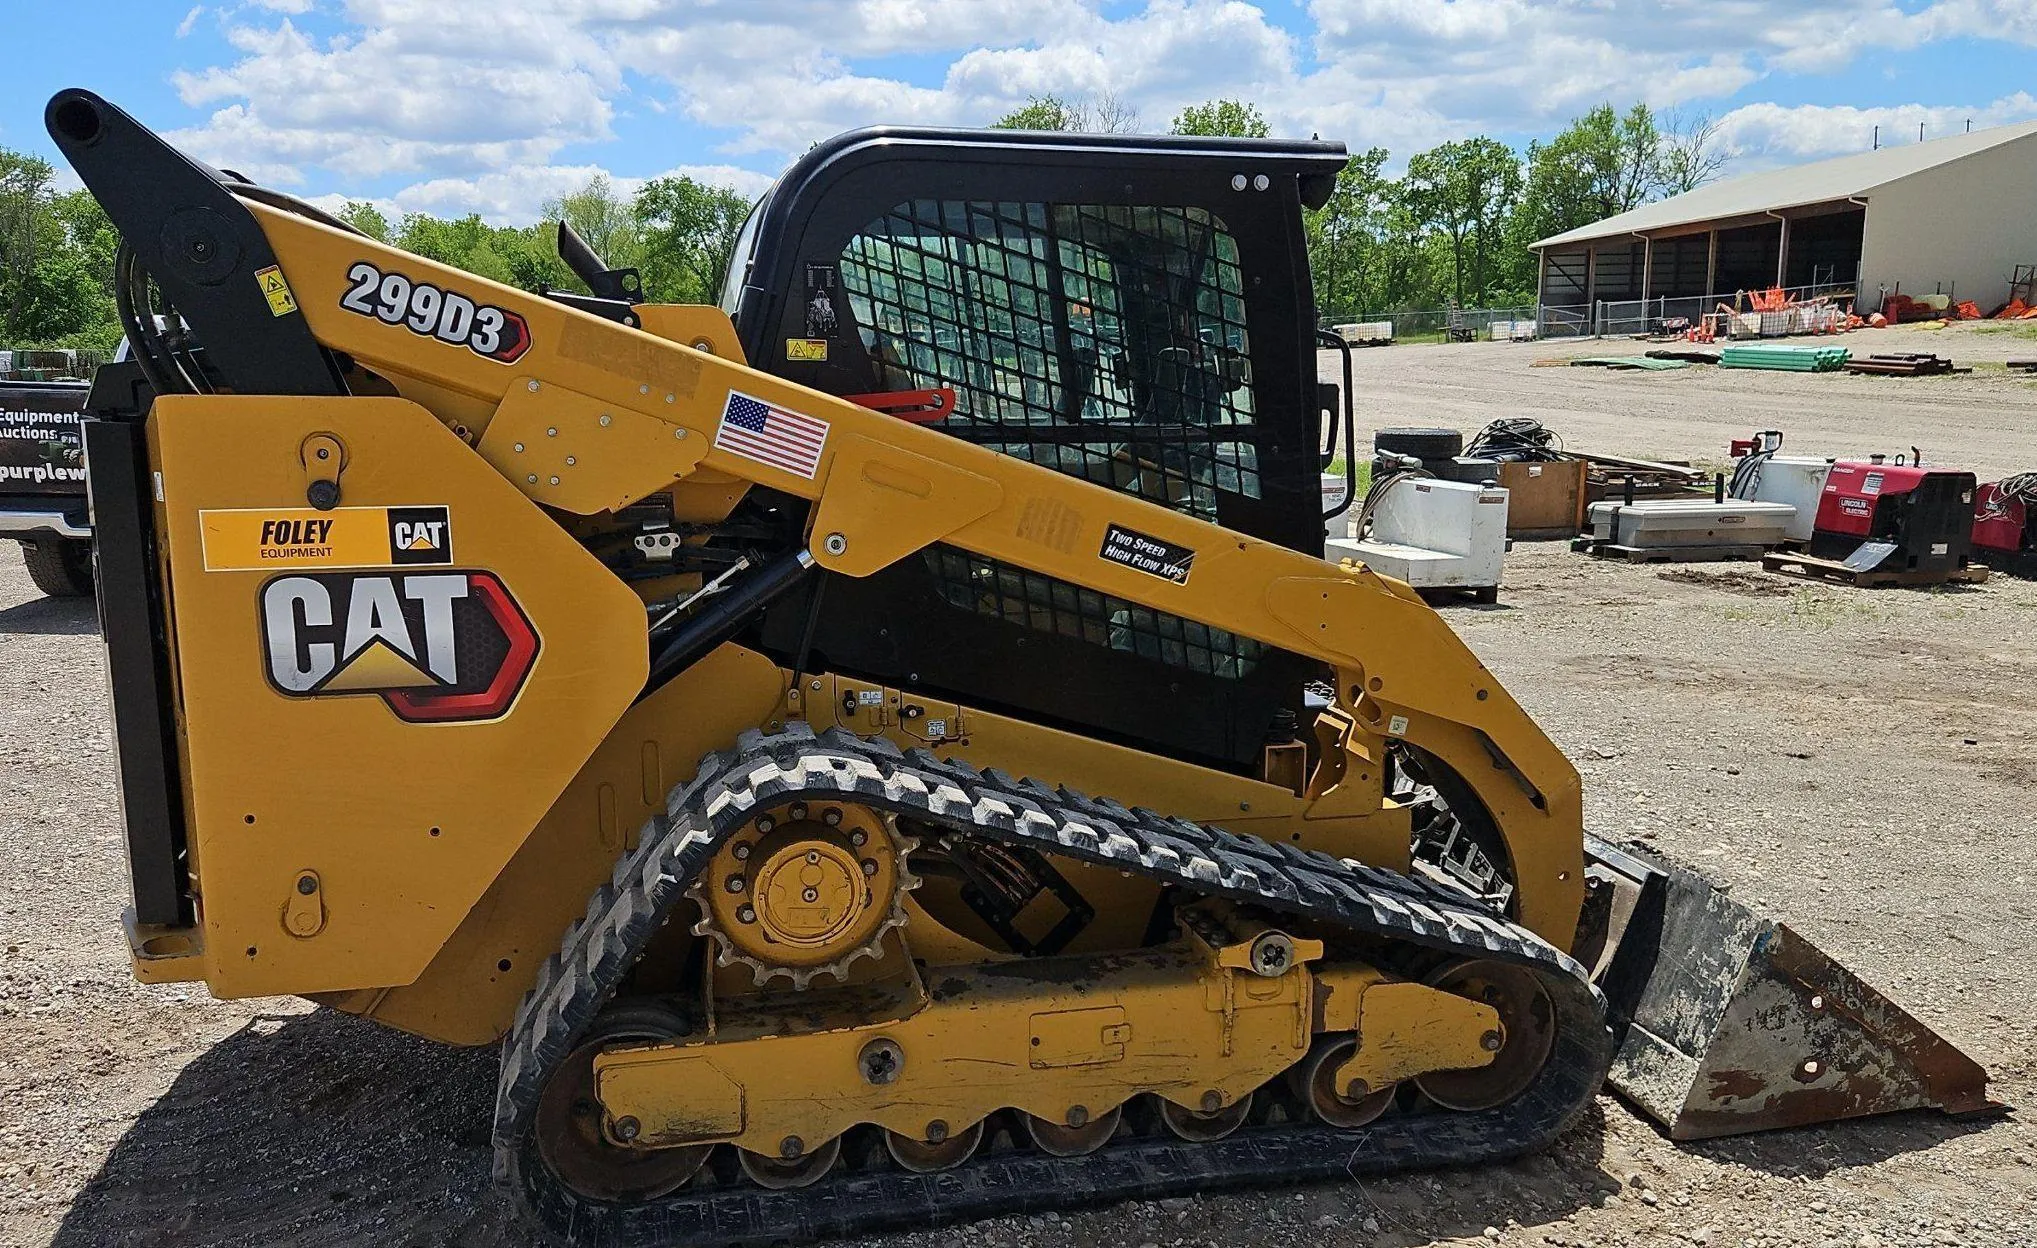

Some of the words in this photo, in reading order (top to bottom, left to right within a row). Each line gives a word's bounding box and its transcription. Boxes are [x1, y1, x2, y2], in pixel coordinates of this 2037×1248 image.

[342, 263, 505, 353] 299D3
[0, 407, 80, 426] Equipment
[1840, 499, 1867, 509] LINCOLN
[260, 519, 334, 546] FOLEY
[394, 521, 442, 550] CAT
[260, 547, 333, 559] EQUIPMENT
[1159, 562, 1186, 580] XPS
[264, 574, 469, 692] CAT
